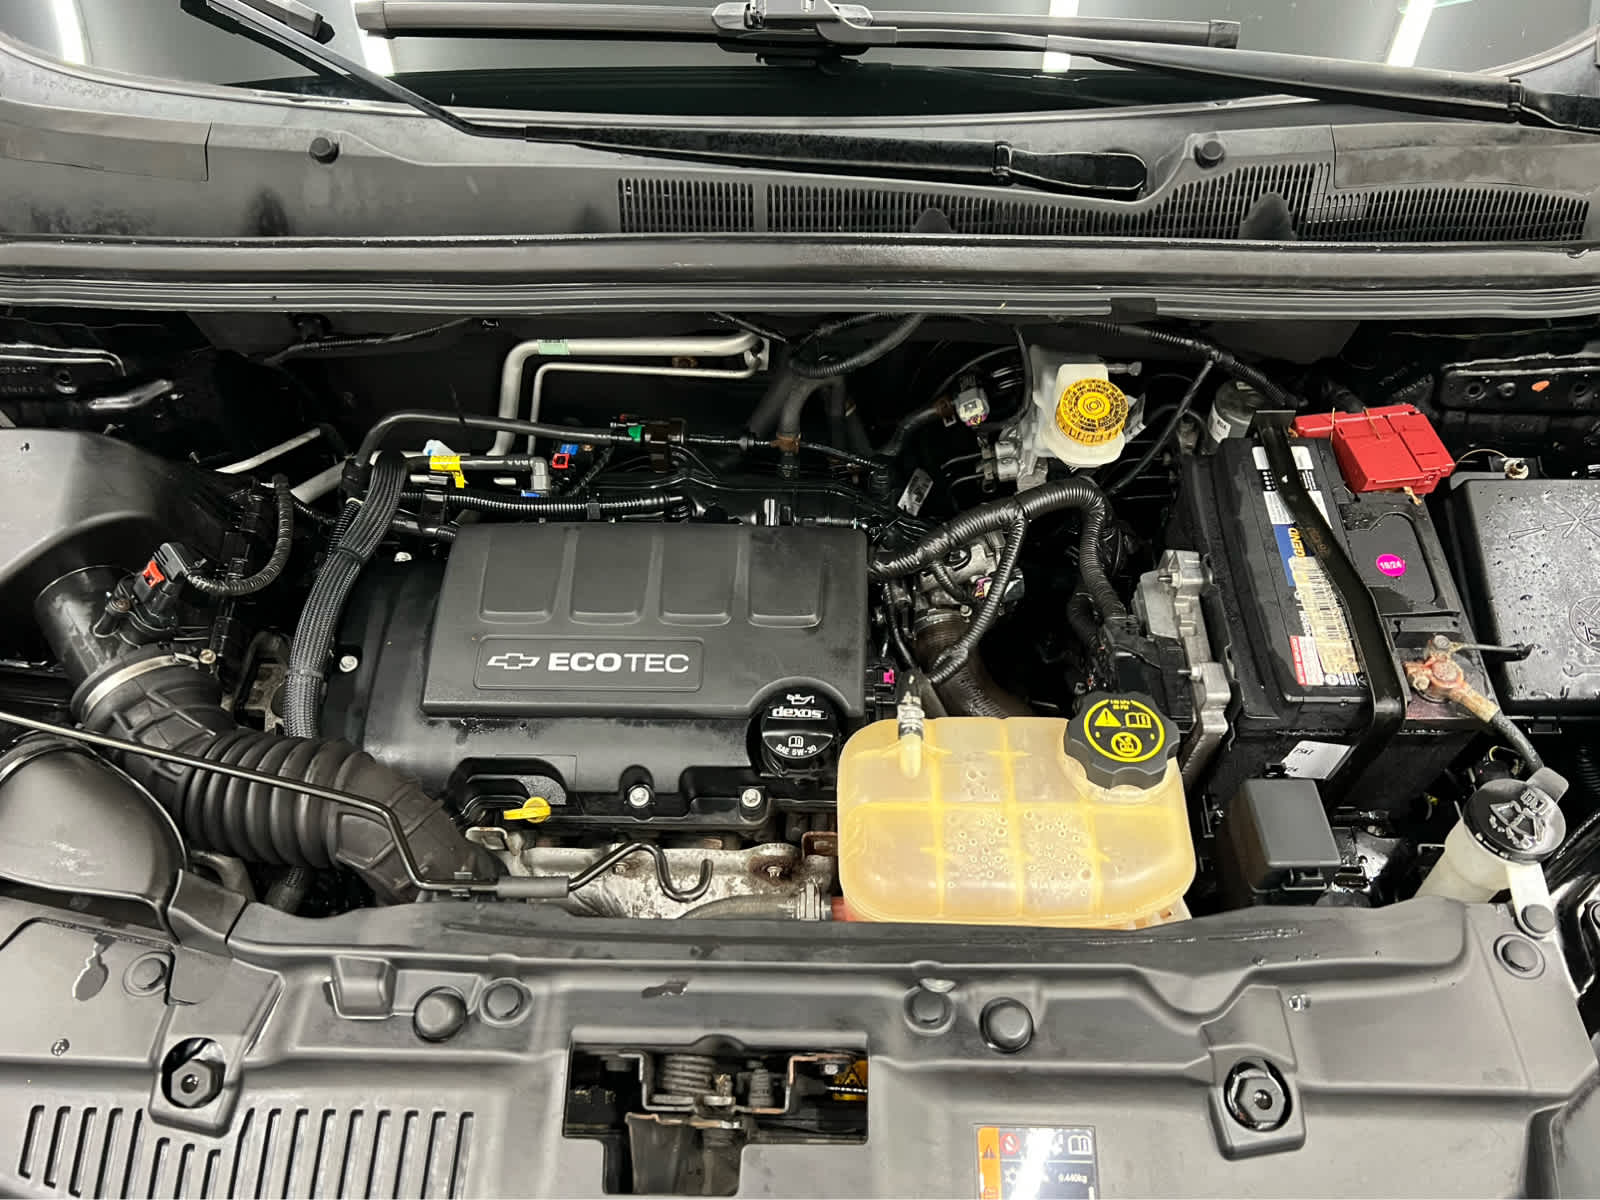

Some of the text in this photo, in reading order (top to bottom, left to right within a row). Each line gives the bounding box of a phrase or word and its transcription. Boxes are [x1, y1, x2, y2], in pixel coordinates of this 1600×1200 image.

[1288, 527, 1306, 558] GEND
[548, 652, 689, 673] ECOTEC
[771, 706, 824, 718] dexos
[775, 743, 817, 756] SAE 5W-30
